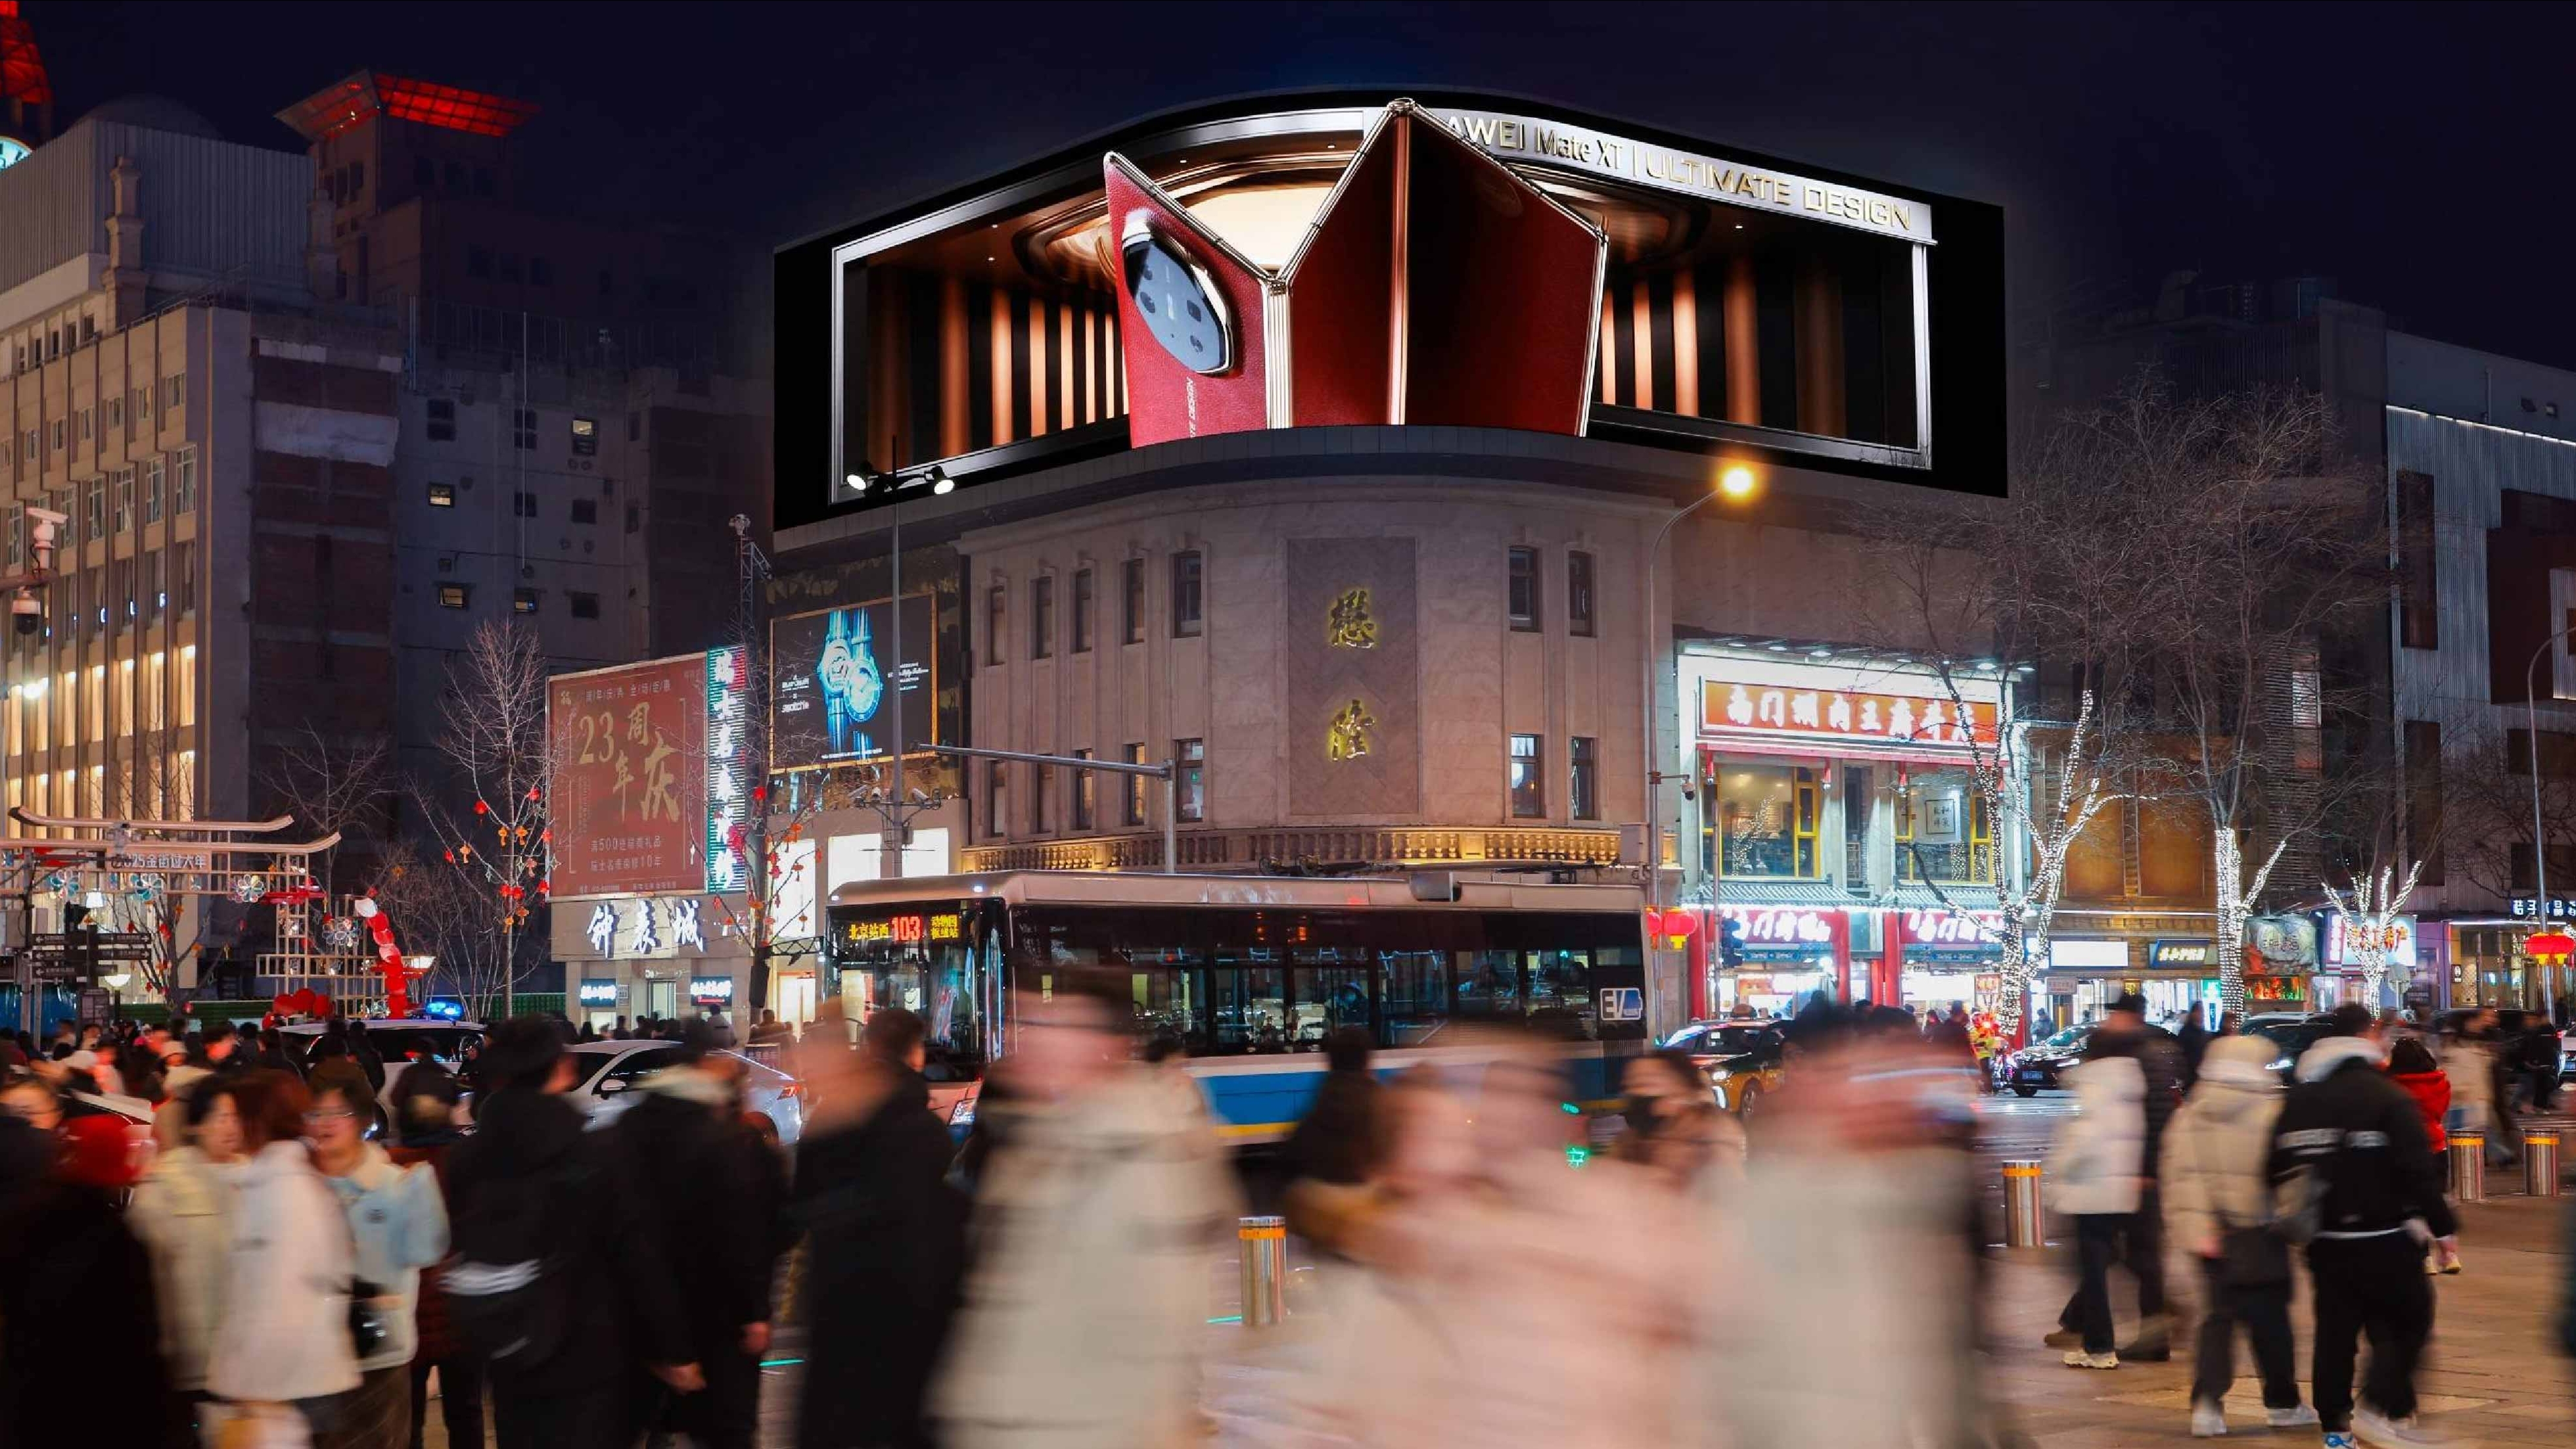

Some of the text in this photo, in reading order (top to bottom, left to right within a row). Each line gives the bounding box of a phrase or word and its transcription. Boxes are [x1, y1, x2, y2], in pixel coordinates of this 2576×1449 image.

[1536, 125, 1592, 162] Mate
[1597, 139, 1623, 170] XT
[1645, 150, 1792, 206] ULTIMATE
[1803, 185, 1910, 231] DESIGN
[587, 899, 704, 958] 钟表城
[849, 916, 921, 940] 北京站西 103
